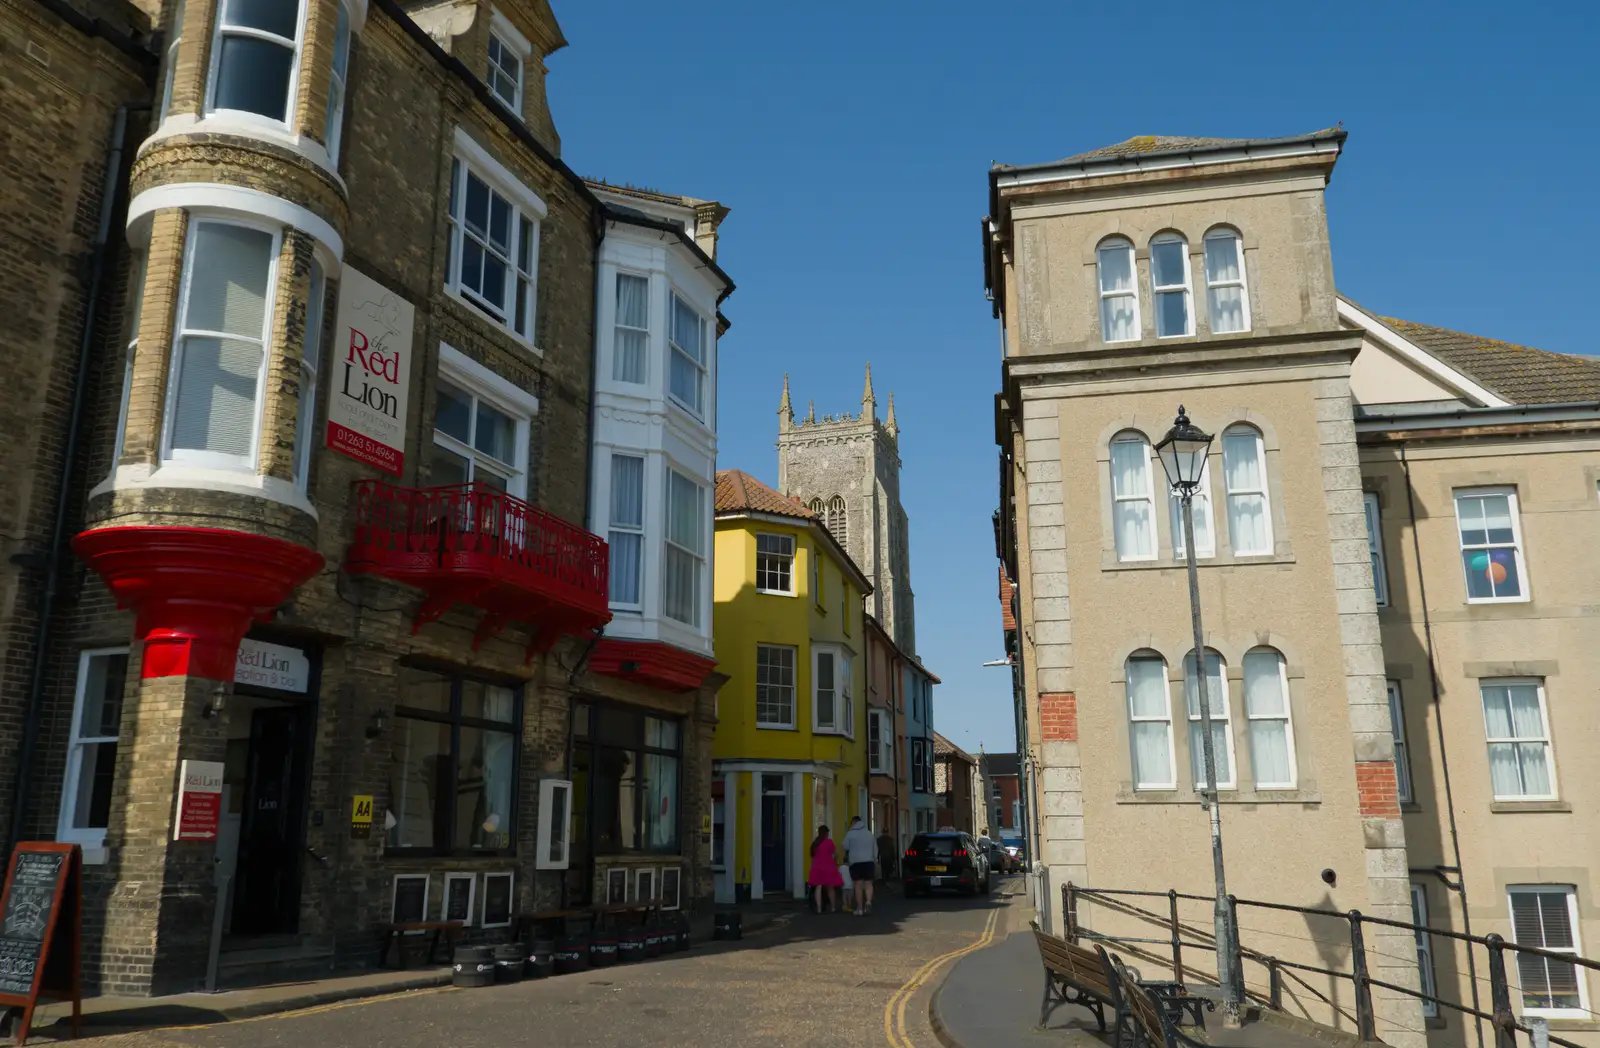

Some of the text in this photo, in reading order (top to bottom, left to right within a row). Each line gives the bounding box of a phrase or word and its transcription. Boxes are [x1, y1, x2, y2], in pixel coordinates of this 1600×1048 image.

[370, 331, 389, 354] the
[345, 326, 400, 384] Red
[341, 361, 399, 420] Lion
[337, 428, 396, 462] 01263 514964
[262, 652, 290, 673] Lion
[186, 775, 221, 789] Red Lion
[258, 797, 278, 810] Lion
[355, 801, 371, 816] AA
